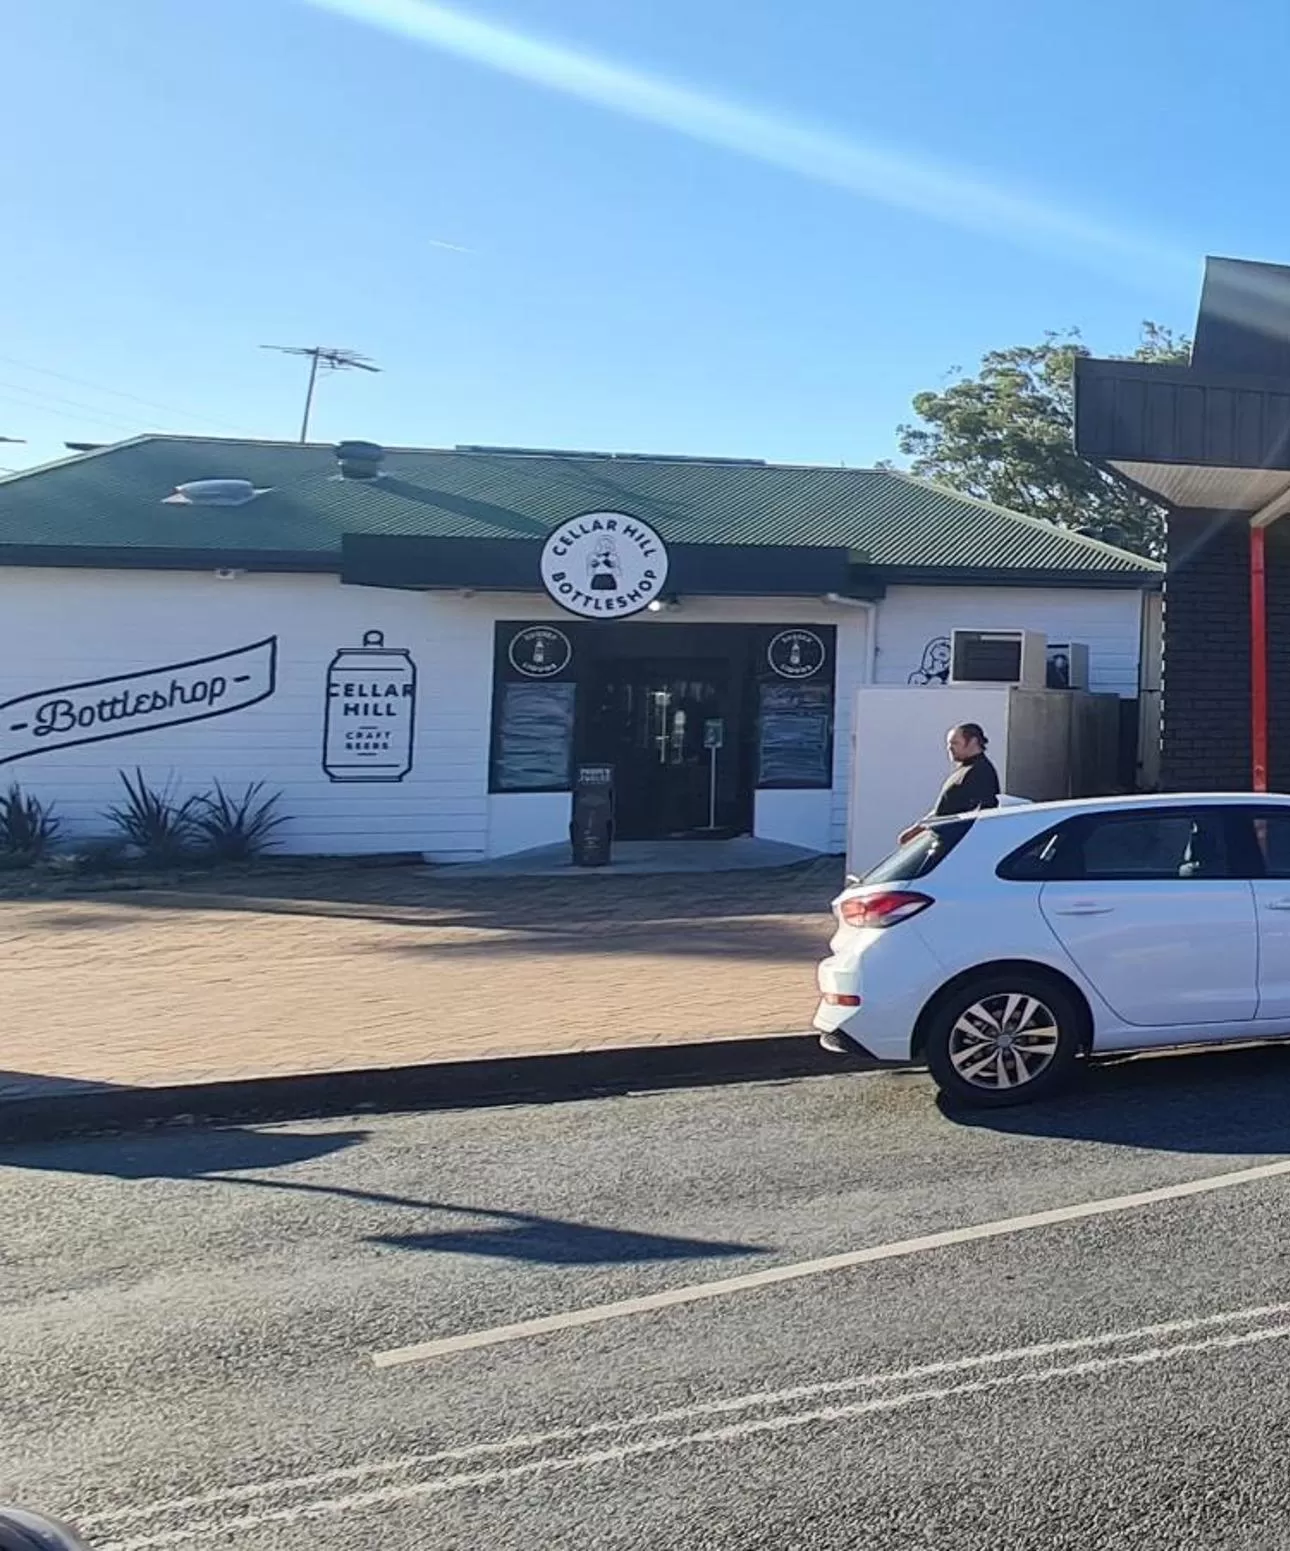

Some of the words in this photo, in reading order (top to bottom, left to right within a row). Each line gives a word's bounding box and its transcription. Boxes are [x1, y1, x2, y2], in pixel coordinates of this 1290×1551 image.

[552, 519, 618, 556] CELLAR
[622, 524, 657, 558] HILL
[552, 569, 657, 611] BOTTLESHOP
[327, 683, 415, 698] CELLAR
[33, 676, 226, 737] Bottleshop
[343, 702, 397, 717] HILL
[345, 731, 390, 740] CRAFT
